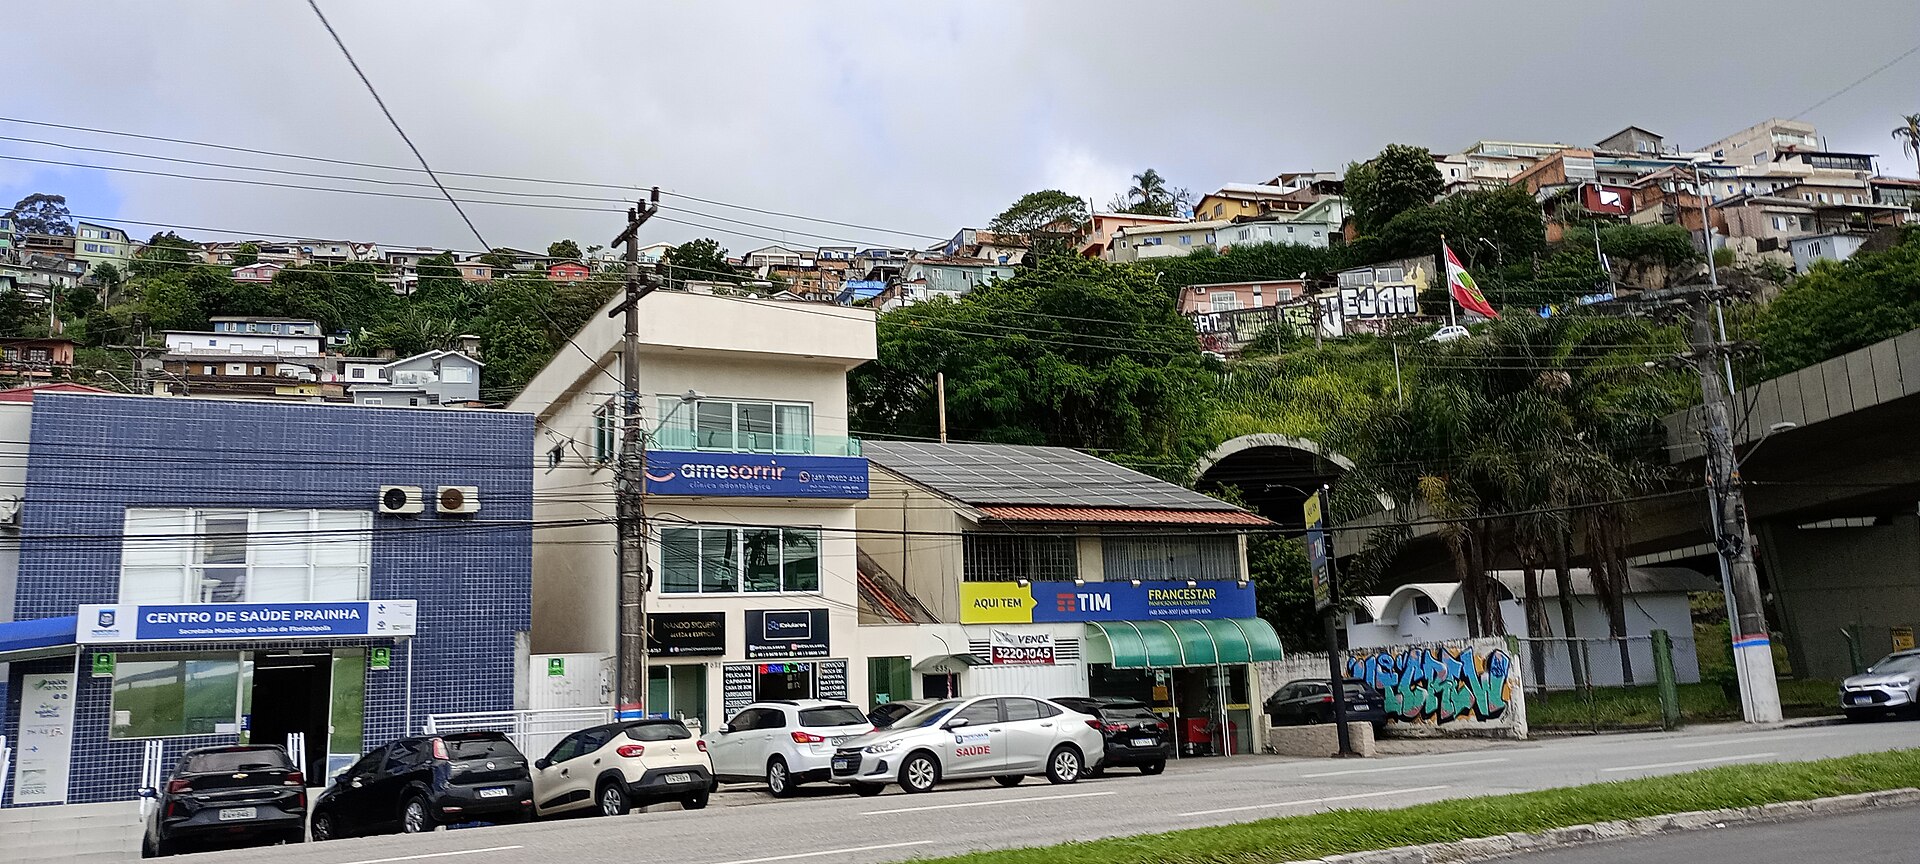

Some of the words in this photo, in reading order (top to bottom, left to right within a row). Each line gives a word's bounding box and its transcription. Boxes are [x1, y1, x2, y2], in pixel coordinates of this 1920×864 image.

[681, 460, 786, 481] amesorrir
[1148, 589, 1216, 600] FRANCESTAR
[974, 599, 998, 609] AQUI
[1002, 598, 1022, 608] TEM
[1077, 593, 1111, 612] TIM
[146, 612, 211, 623] CENTRO
[215, 612, 236, 622] DE
[240, 608, 291, 621] SAÚDE
[294, 609, 360, 620] PRAINHA
[996, 647, 1051, 659] 3220-1045
[956, 745, 991, 757] SAÚDE
